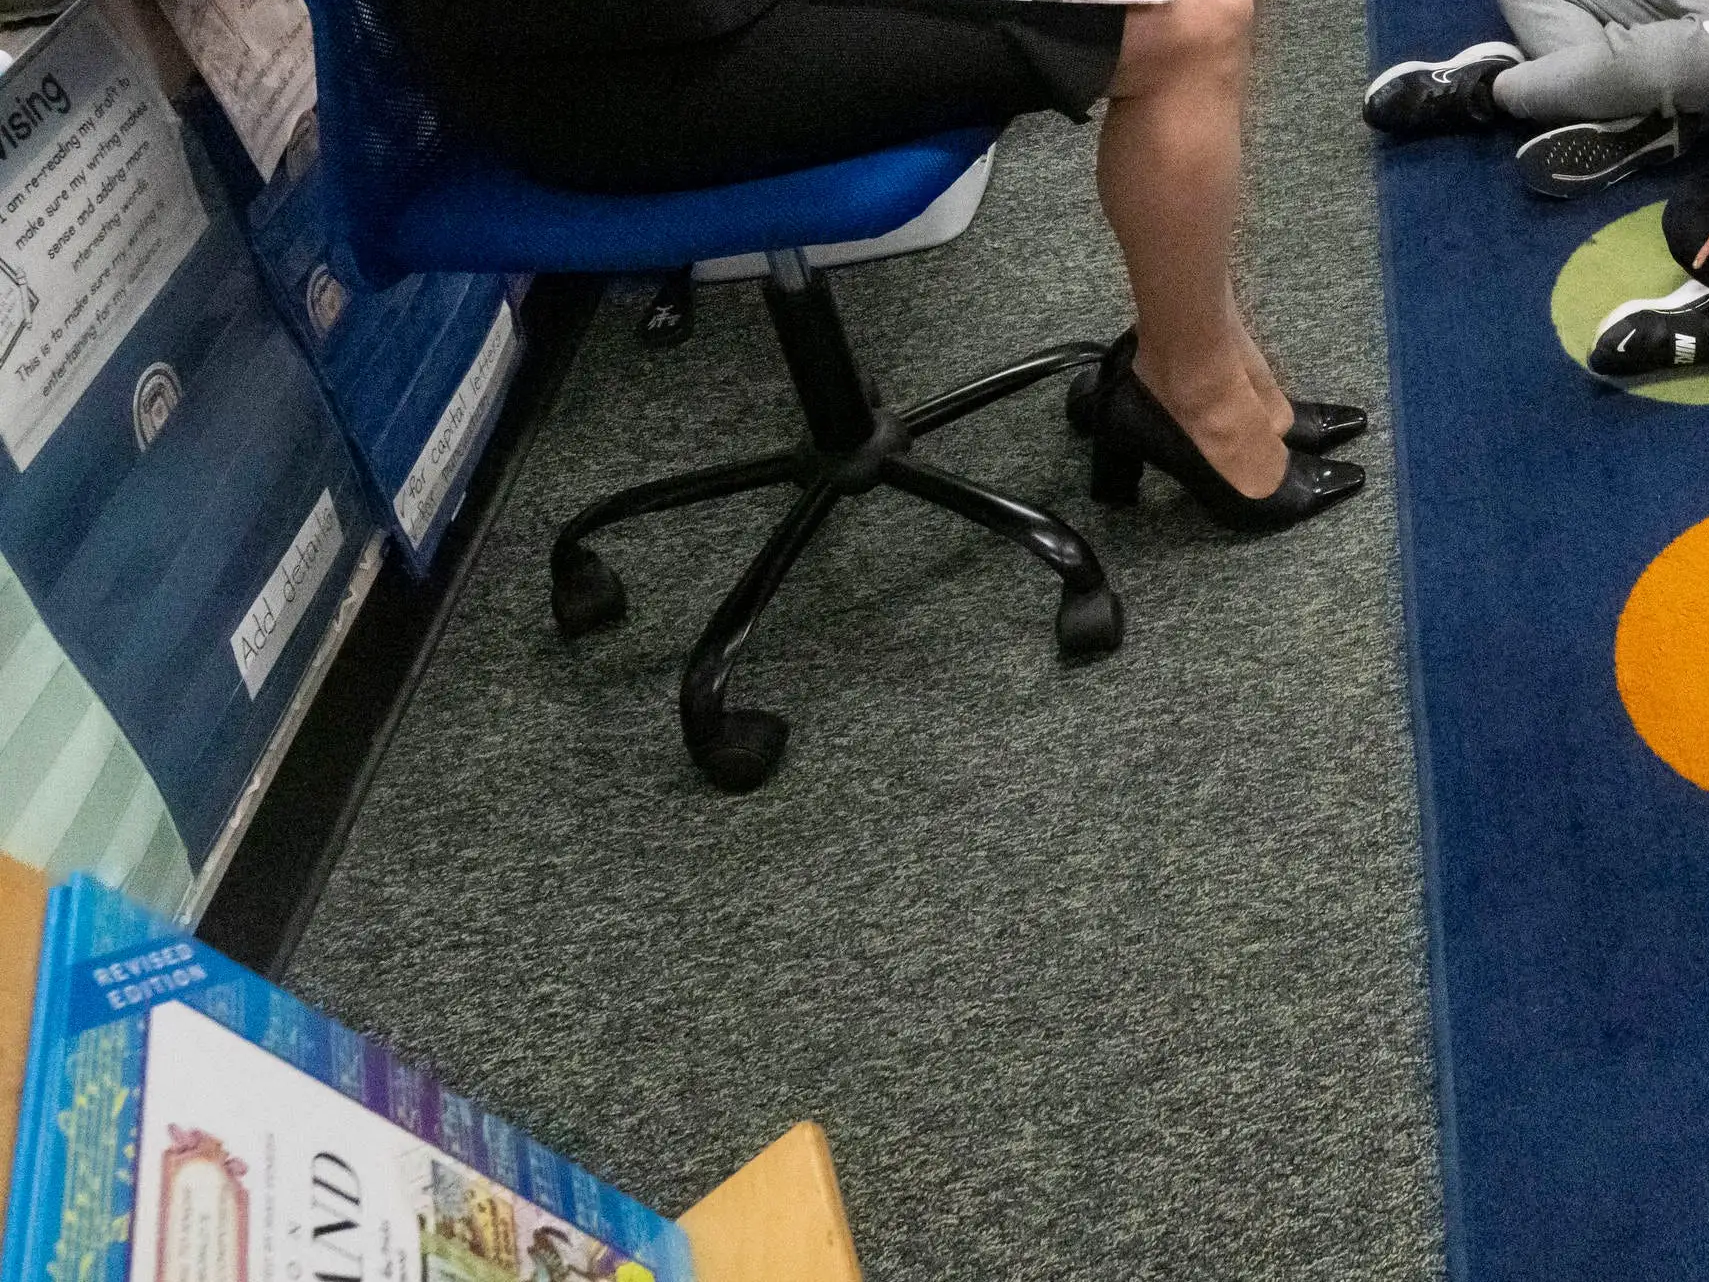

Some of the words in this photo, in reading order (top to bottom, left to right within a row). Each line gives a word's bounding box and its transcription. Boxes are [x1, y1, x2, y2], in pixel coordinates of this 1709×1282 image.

[6, 192, 26, 214] am
[25, 134, 81, 195] re-reading
[78, 117, 97, 138] my
[94, 86, 120, 119] draft
[117, 77, 131, 95] to
[15, 216, 46, 251] make
[45, 189, 70, 218] sure
[69, 170, 87, 195] my
[87, 132, 122, 171] writing
[120, 102, 149, 136] makes
[47, 225, 77, 261] sense
[76, 202, 96, 228] and
[95, 167, 129, 207] adding
[125, 139, 151, 172] more
[15, 356, 42, 383] This
[40, 341, 51, 358] is
[50, 326, 65, 345] to
[63, 297, 91, 331] make
[408, 469, 427, 500] for
[431, 391, 467, 465] capital
[241, 596, 277, 670] Add
[281, 507, 334, 603] details
[93, 944, 193, 986] REVISED
[106, 964, 207, 1010] EDITION
[311, 1151, 362, 1282] ND
